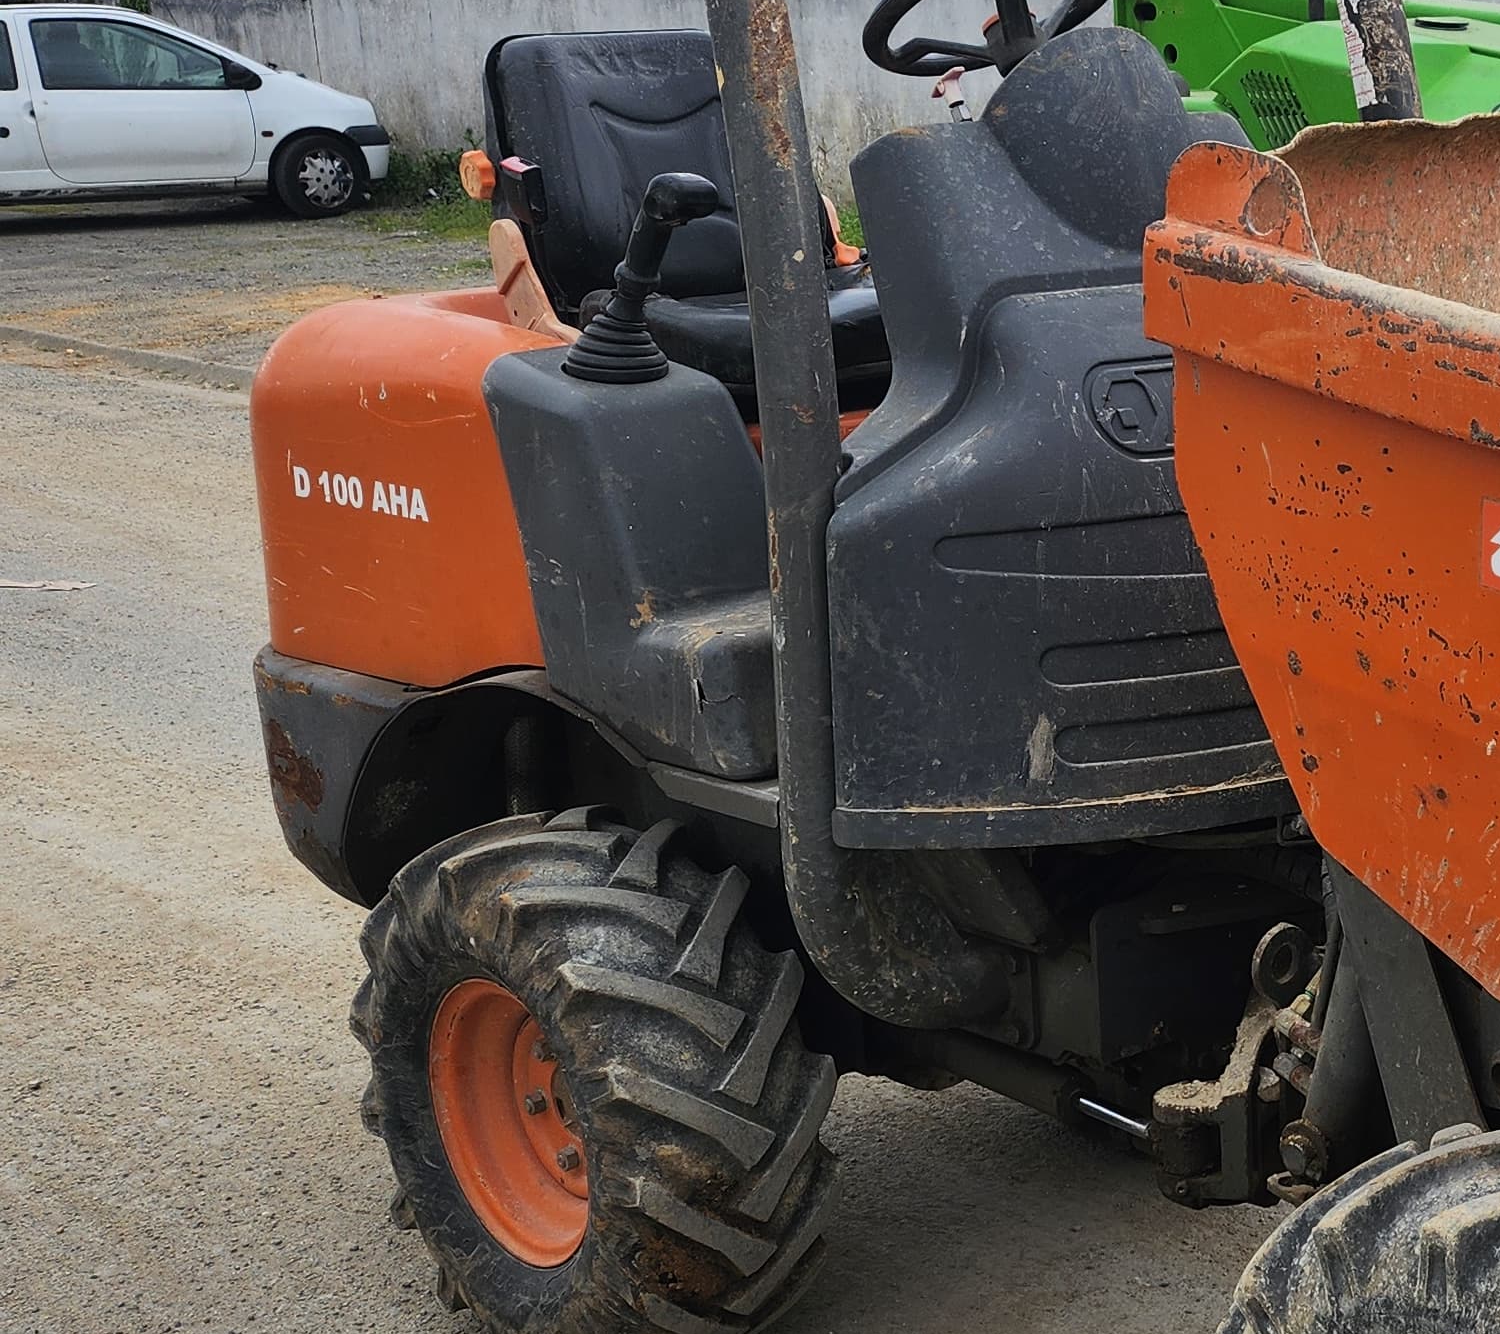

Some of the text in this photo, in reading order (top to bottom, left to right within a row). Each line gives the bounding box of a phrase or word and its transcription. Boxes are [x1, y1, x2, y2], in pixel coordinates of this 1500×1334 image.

[293, 465, 430, 523] D 100 AHA
